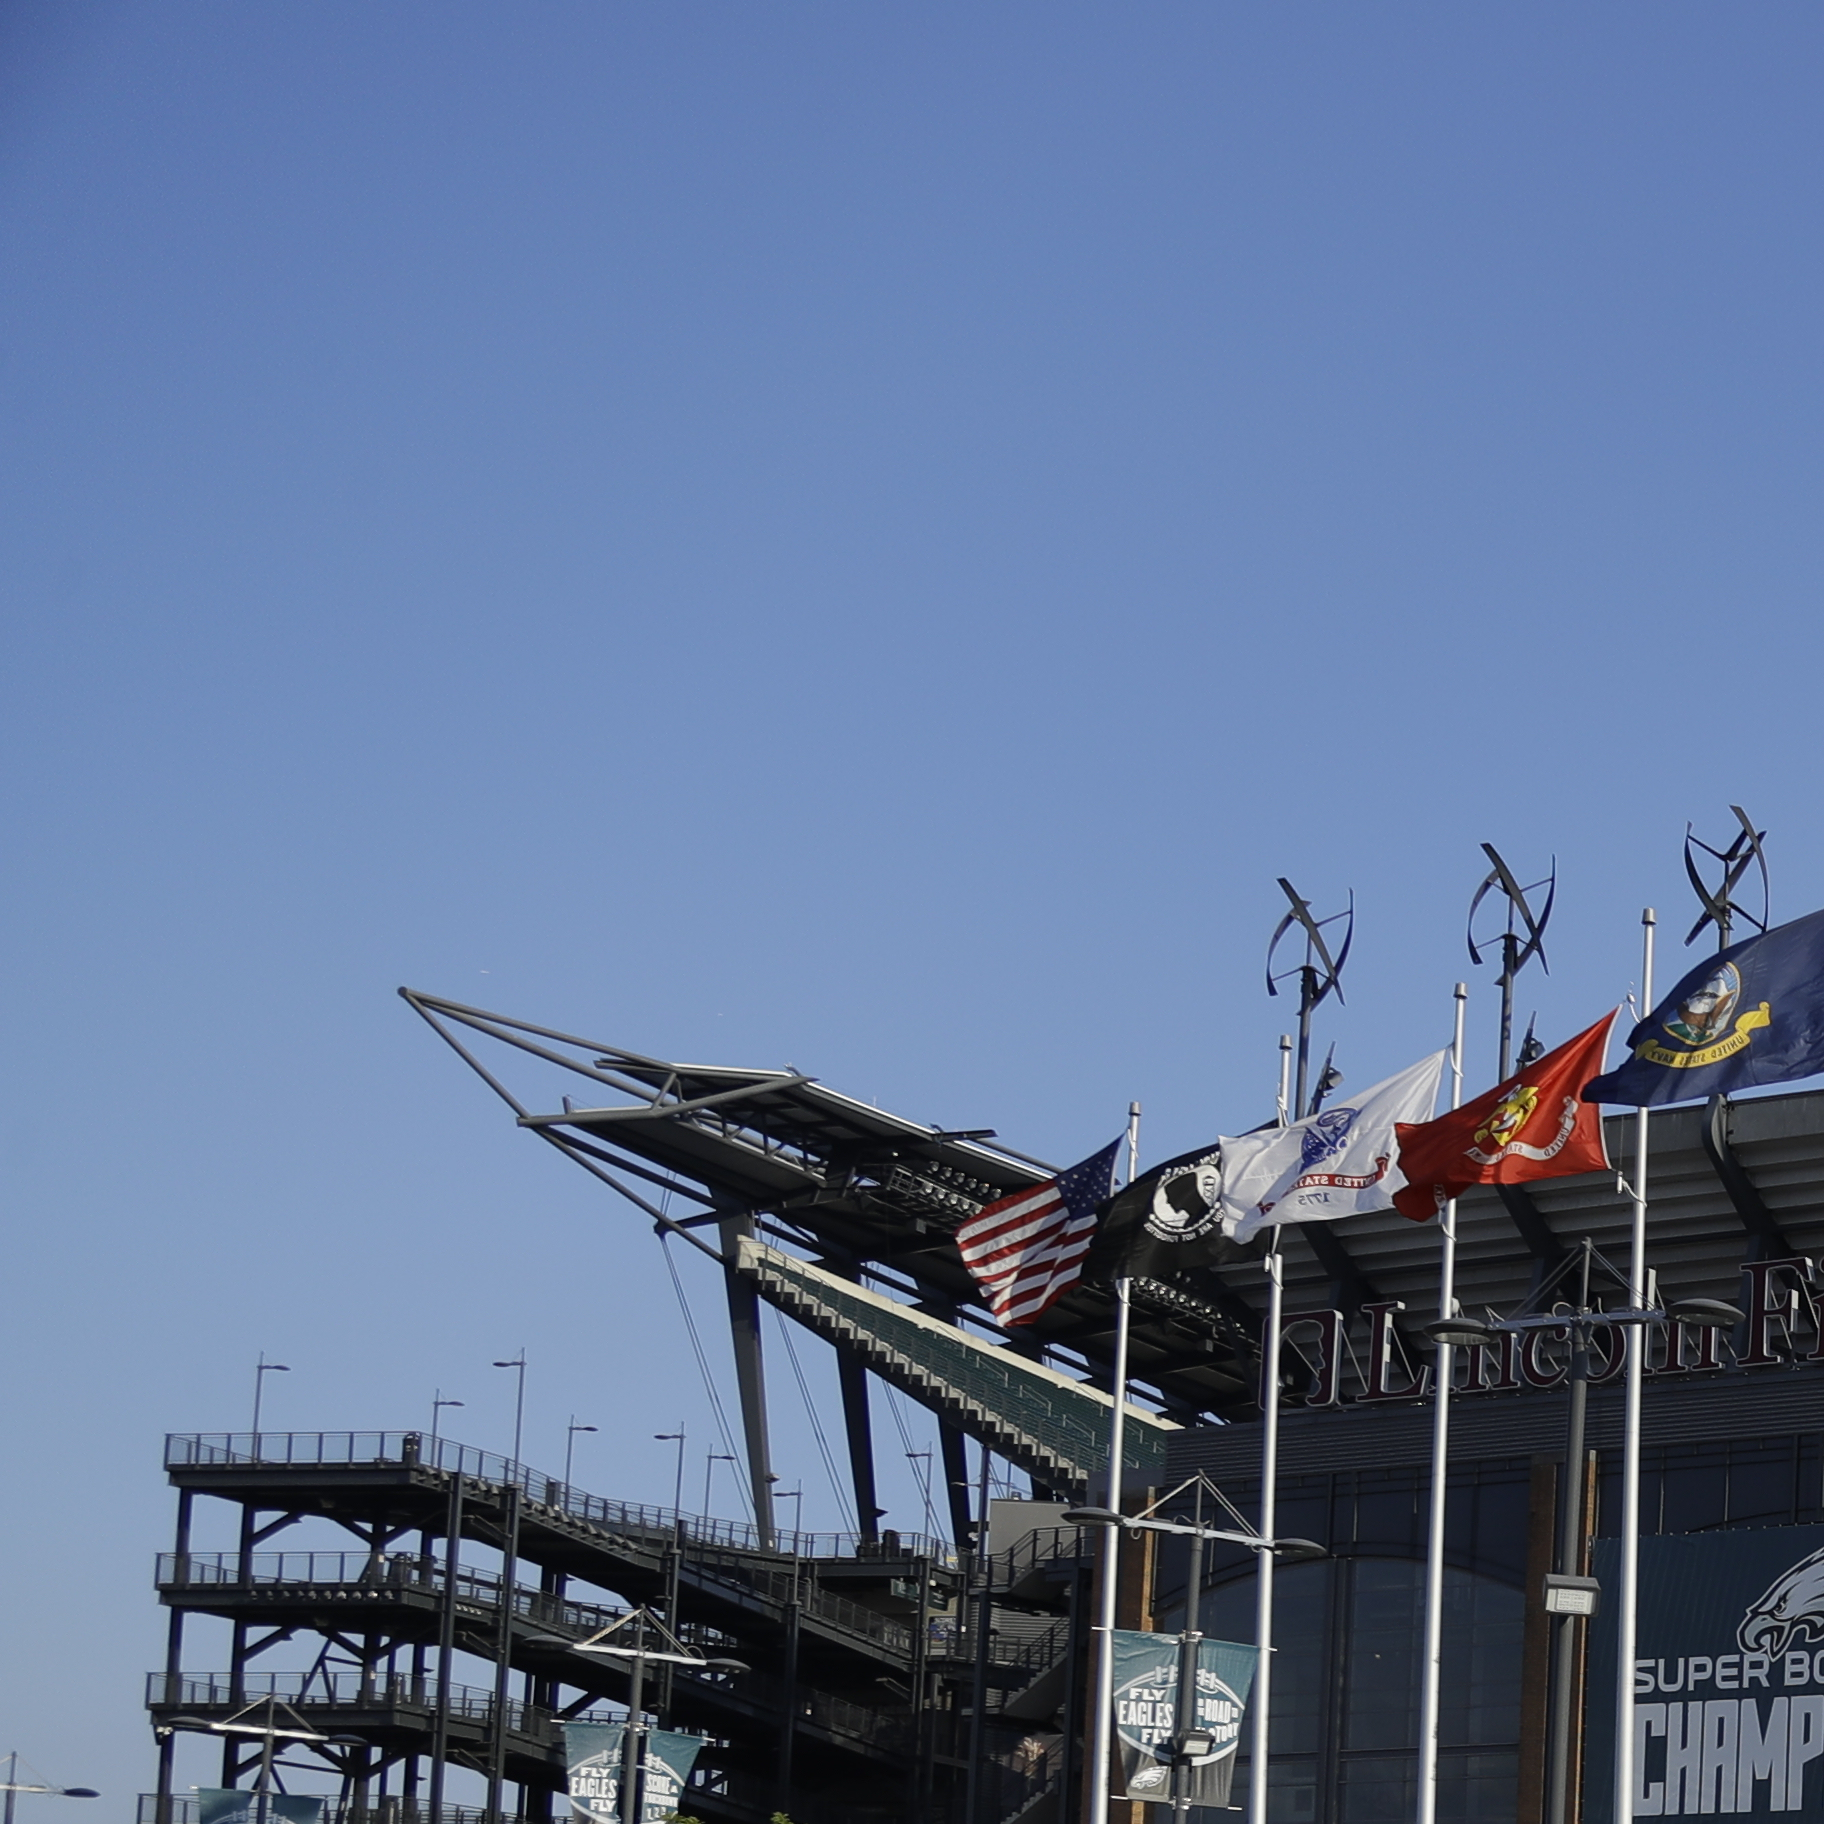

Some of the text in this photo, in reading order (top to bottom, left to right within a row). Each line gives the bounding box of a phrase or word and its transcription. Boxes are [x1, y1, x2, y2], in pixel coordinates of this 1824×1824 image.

[1634, 1654, 1770, 1694] SUPER
[1130, 1688, 1167, 1701] FLY
[1118, 1701, 1174, 1728] EAGLES
[1204, 1698, 1232, 1723] ROAD
[580, 1767, 611, 1777] FLY
[570, 1777, 618, 1799] EAGLES
[590, 1800, 617, 1813] FLY
